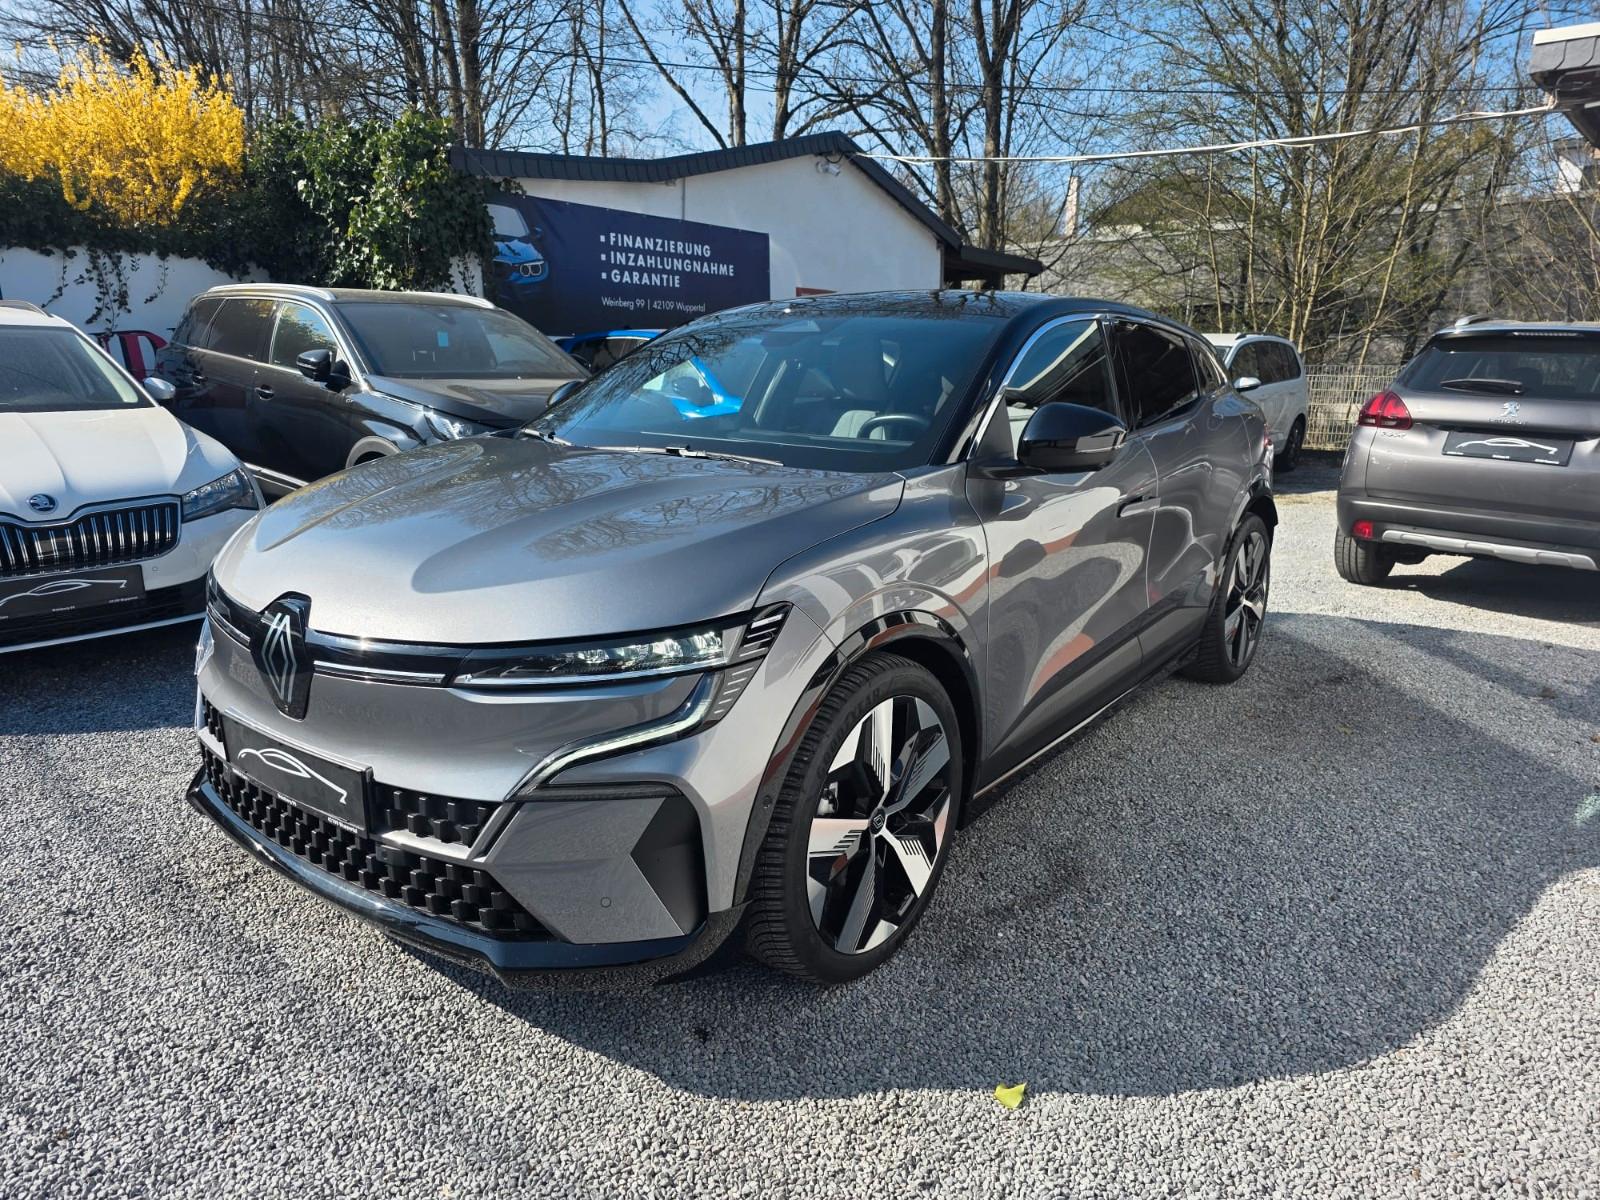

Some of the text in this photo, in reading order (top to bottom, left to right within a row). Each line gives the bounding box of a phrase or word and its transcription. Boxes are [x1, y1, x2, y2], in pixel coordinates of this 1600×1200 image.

[609, 232, 711, 257] FINANZIERUNG
[610, 251, 735, 276] INZAHLUNGNAHME
[611, 269, 680, 288] GARANTIE
[601, 296, 634, 310] Weinberg
[635, 298, 645, 308] 99
[652, 300, 675, 310] 42109
[676, 302, 706, 313] Wuppertal
